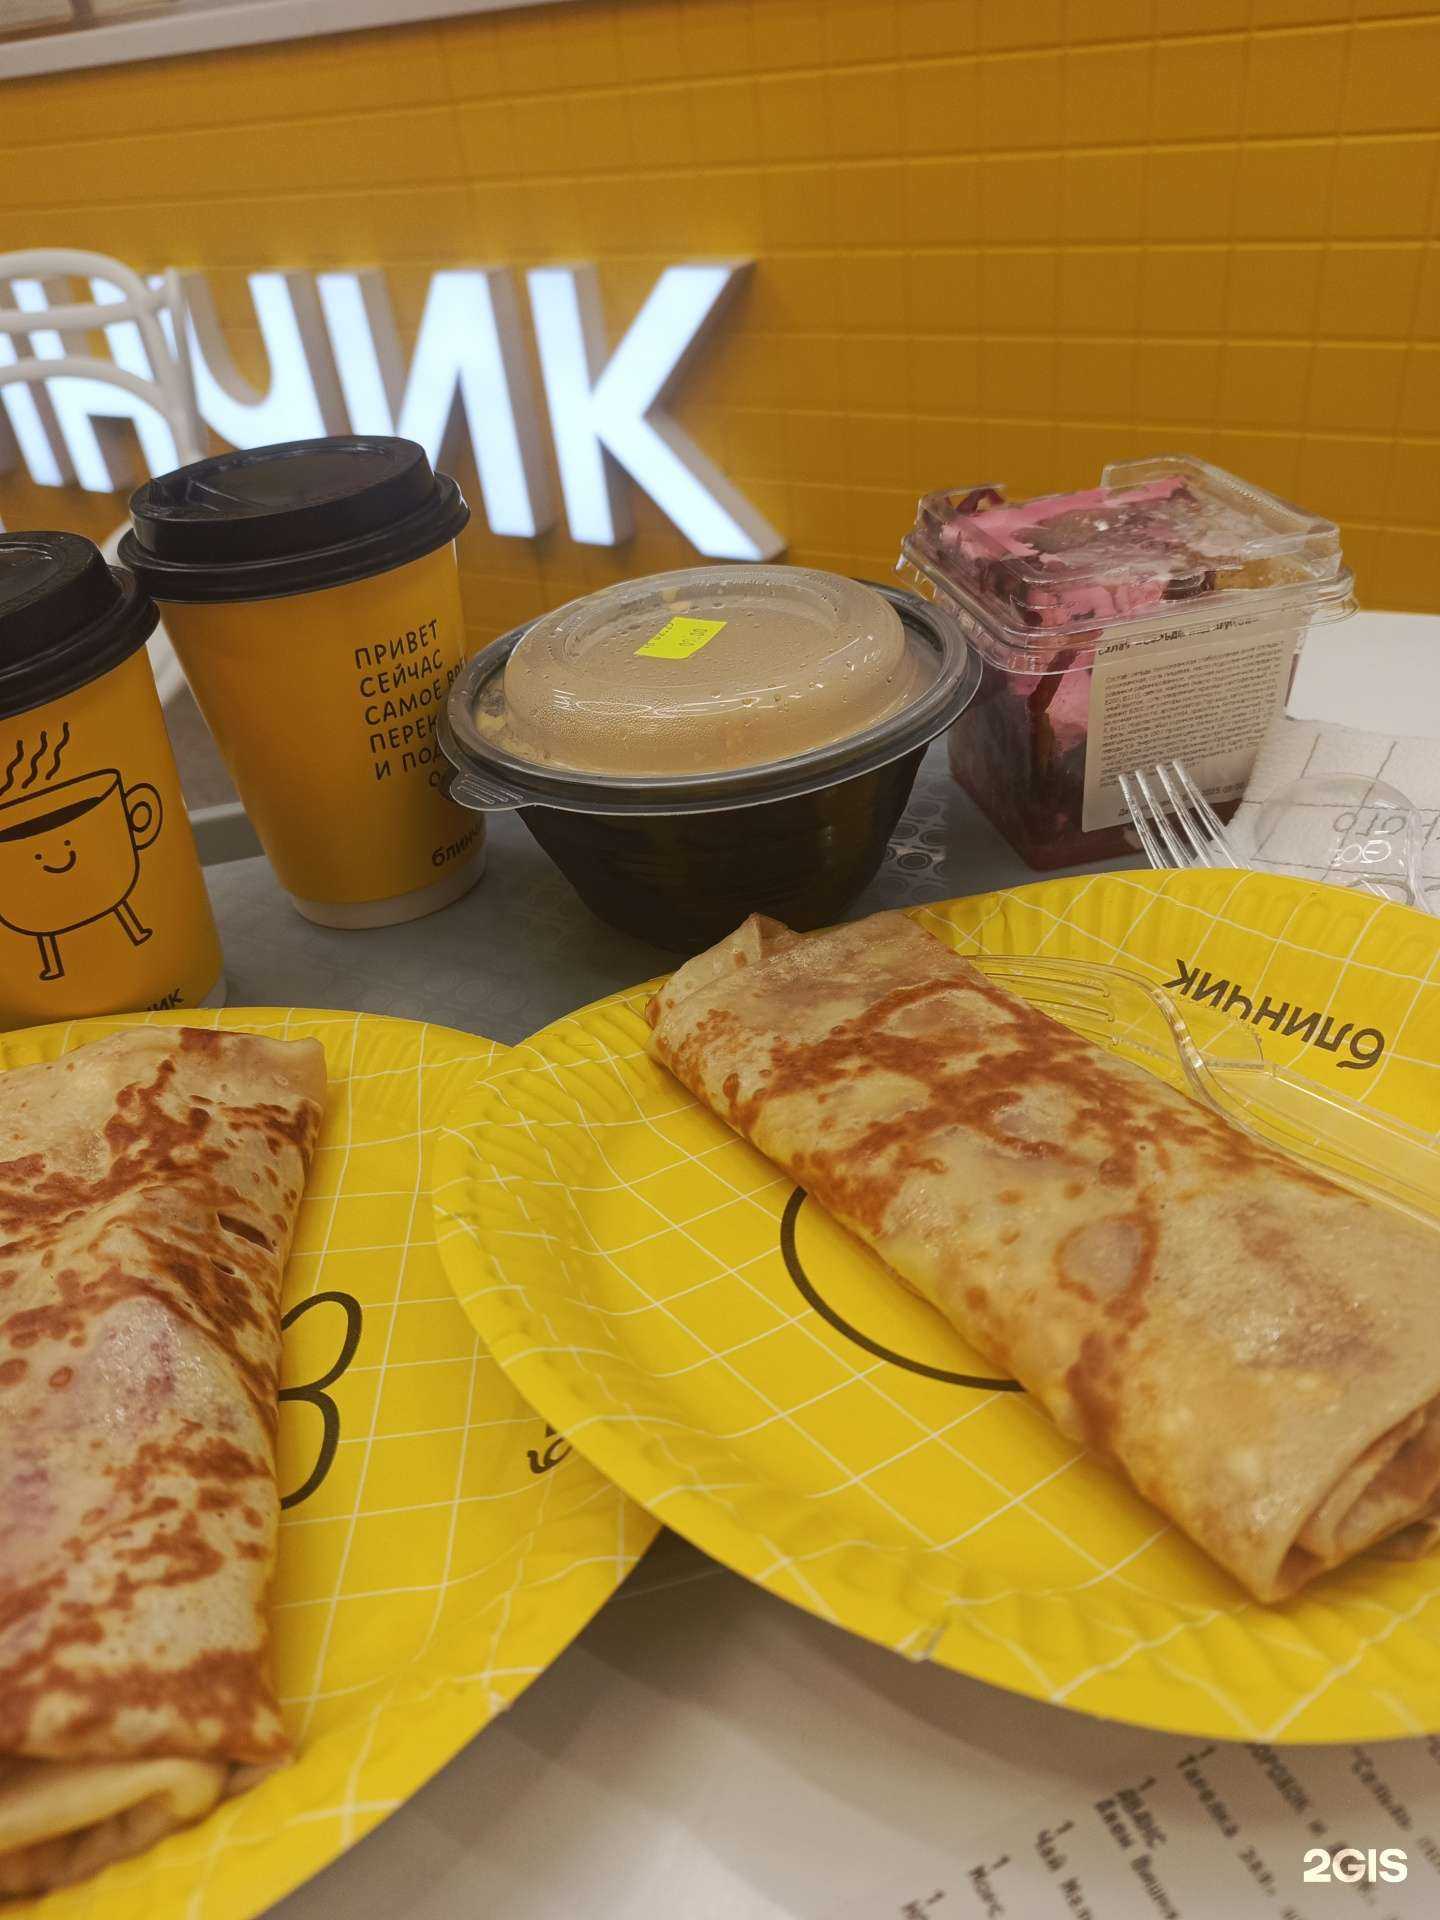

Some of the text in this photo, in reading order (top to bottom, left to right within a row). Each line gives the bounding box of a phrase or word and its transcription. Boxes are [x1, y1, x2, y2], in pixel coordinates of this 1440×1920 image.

[354, 618, 439, 669] ПРИВЕТ
[359, 648, 443, 698] СЕЙЧАС
[364, 679, 442, 726] САМОЕ
[374, 760, 392, 781] И
[1162, 958, 1386, 1070] блинчик
